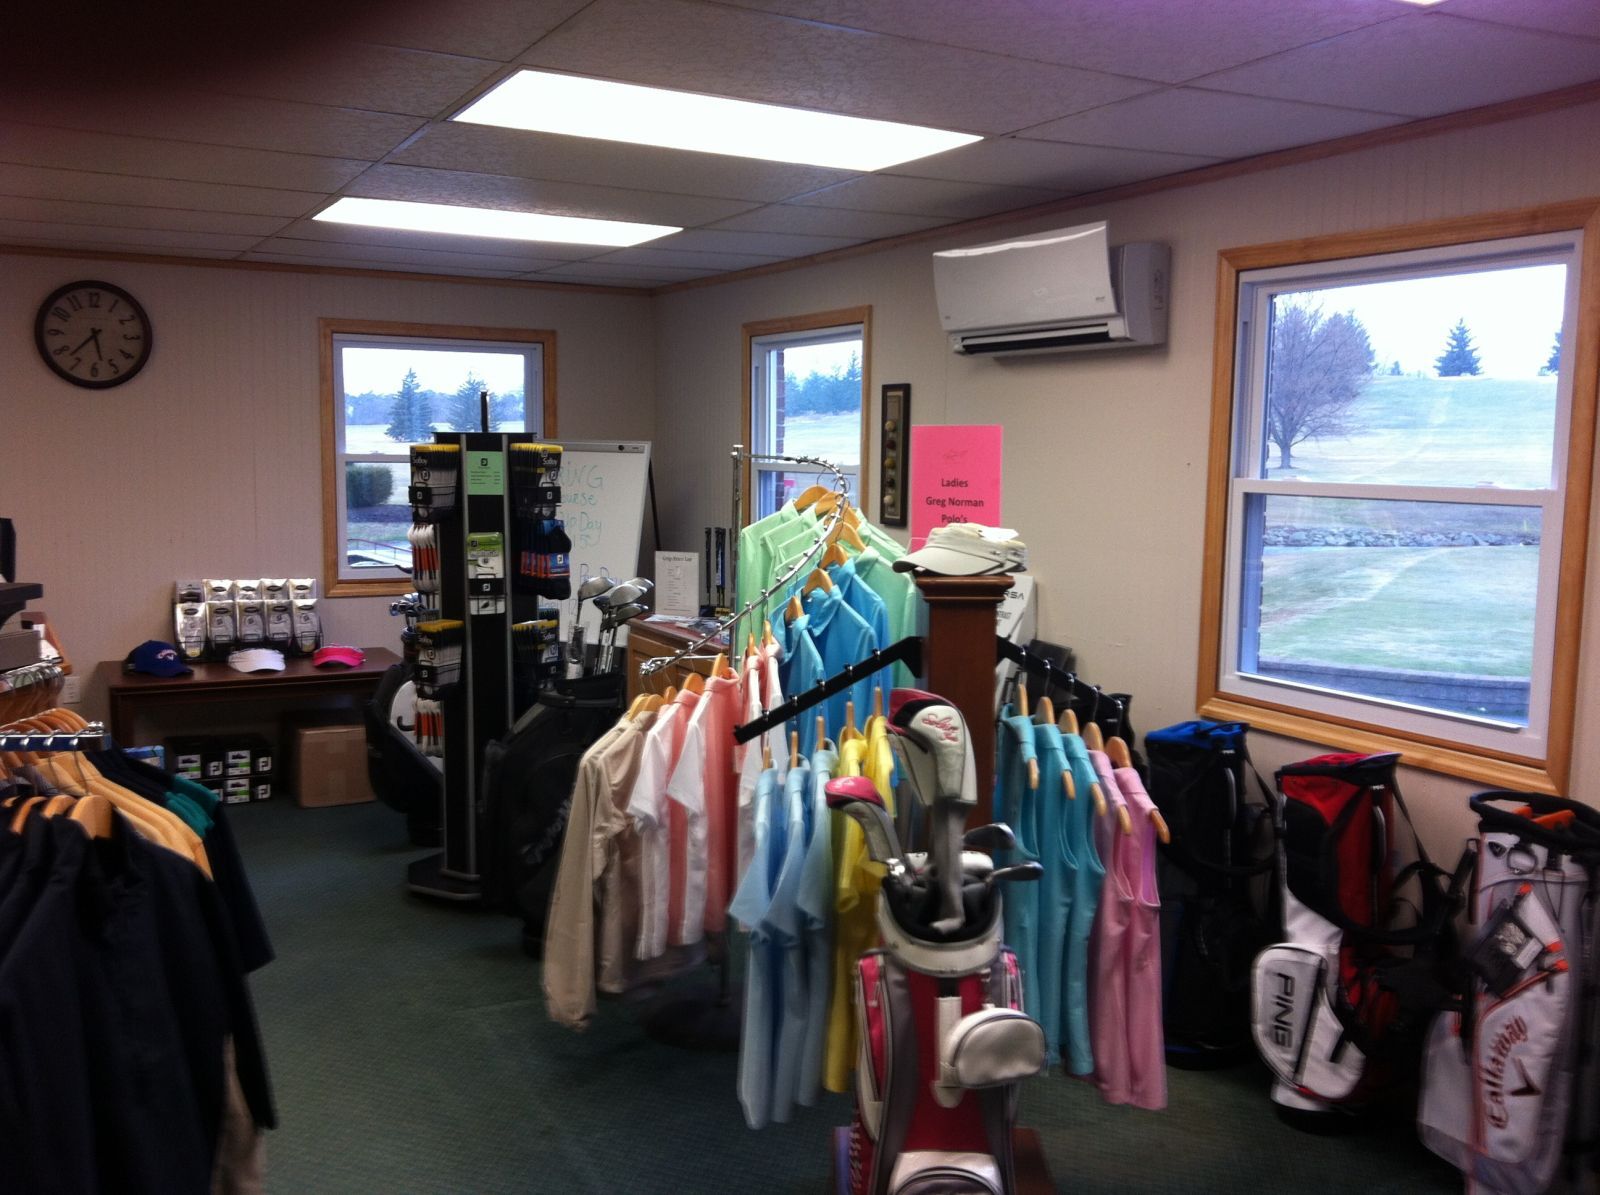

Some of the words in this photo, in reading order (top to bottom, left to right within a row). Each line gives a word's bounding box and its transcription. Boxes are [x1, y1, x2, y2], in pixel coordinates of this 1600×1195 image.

[88, 292, 100, 308] 12
[941, 478, 969, 488] Ladies
[925, 496, 947, 508] Greg
[948, 497, 985, 508] Norman
[941, 514, 968, 524] Polo's
[207, 761, 223, 776] FJ
[257, 757, 272, 772] FJ
[256, 784, 271, 800] FJ
[1272, 972, 1296, 1049] PING
[1480, 1015, 1528, 1130] Callaway
